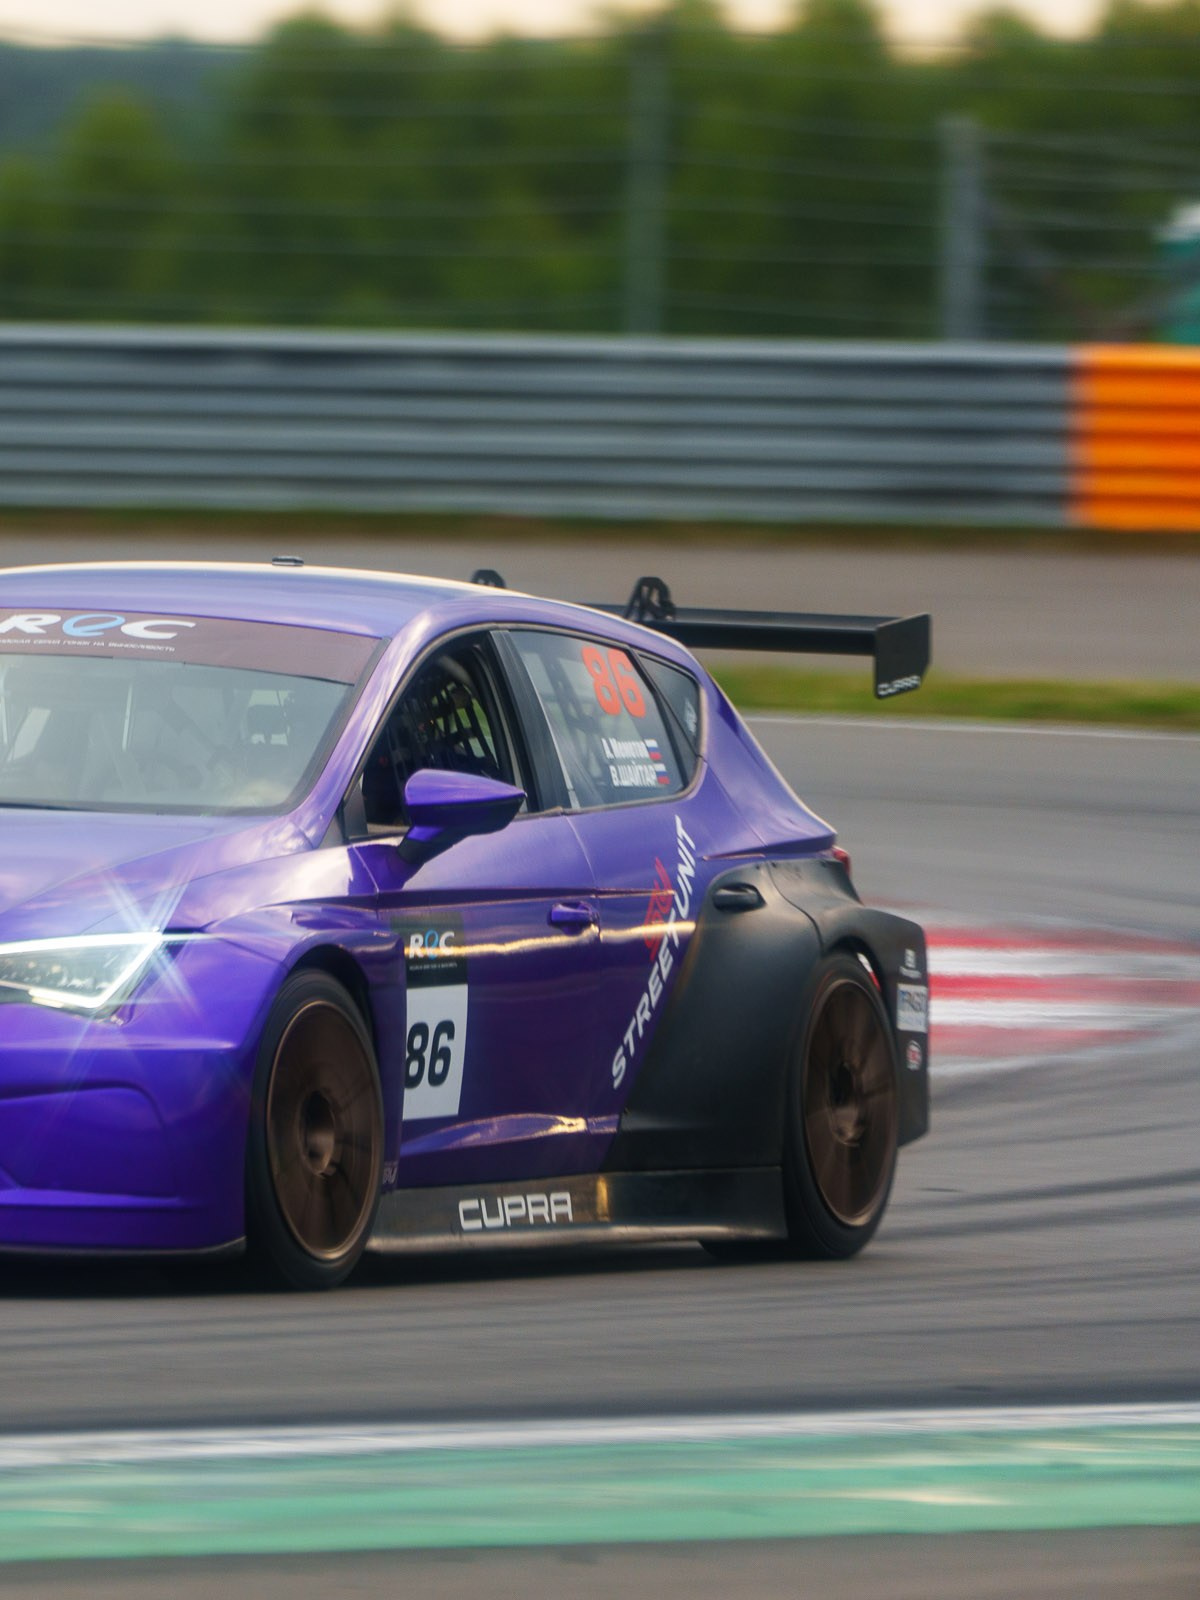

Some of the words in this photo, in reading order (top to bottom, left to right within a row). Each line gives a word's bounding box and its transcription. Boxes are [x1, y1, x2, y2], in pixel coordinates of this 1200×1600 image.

[581, 646, 646, 718] 86
[404, 1019, 455, 1089] 86
[458, 1192, 573, 1230] CUPRA
